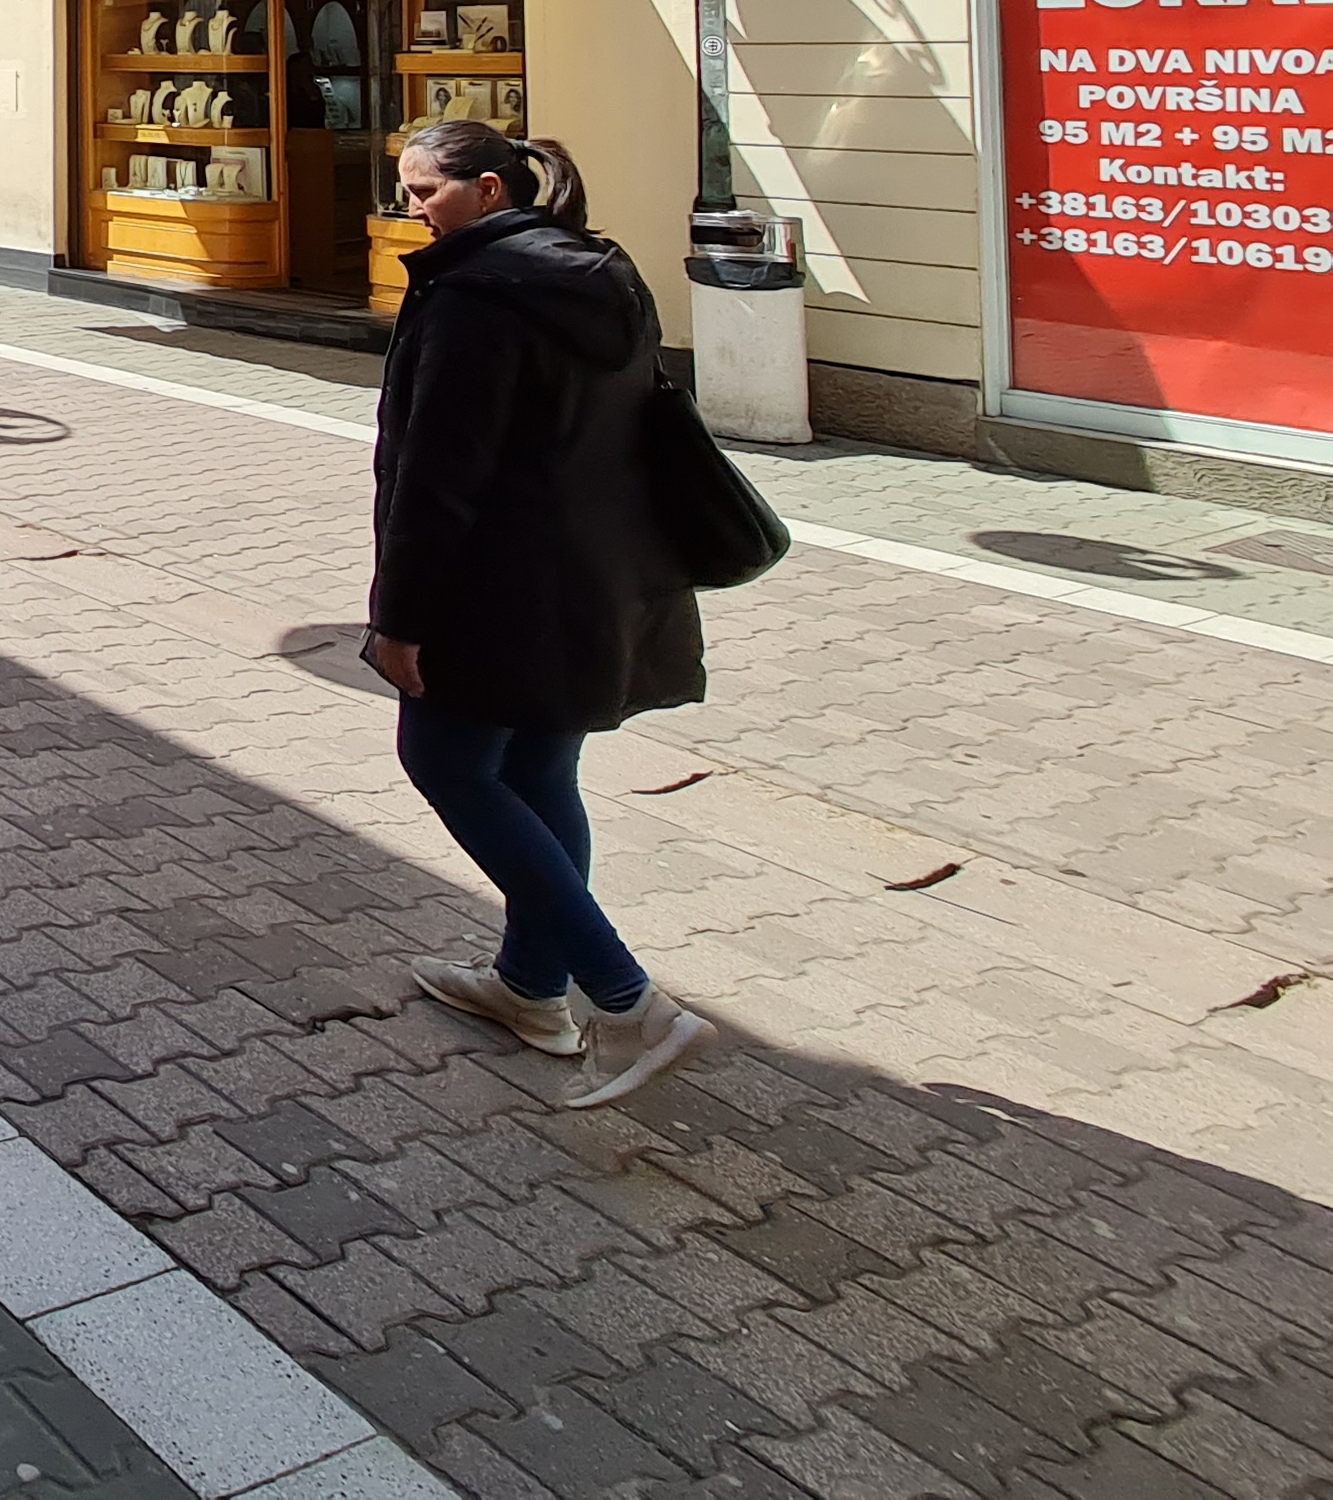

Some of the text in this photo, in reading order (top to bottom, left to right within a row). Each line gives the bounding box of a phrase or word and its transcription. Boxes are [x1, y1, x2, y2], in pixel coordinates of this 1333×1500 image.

[1039, 49, 1096, 72] NA
[1108, 49, 1193, 73] DVA
[1078, 80, 1305, 114] POVRŠINA
[1039, 120, 1088, 144] 95
[1101, 122, 1162, 147] M2
[1174, 127, 1200, 146] +
[1212, 126, 1269, 152] 95
[1099, 158, 1285, 192] Kontakt:
[1015, 190, 1333, 234] +38163/10303
[1015, 227, 1333, 274] +38163/10619
